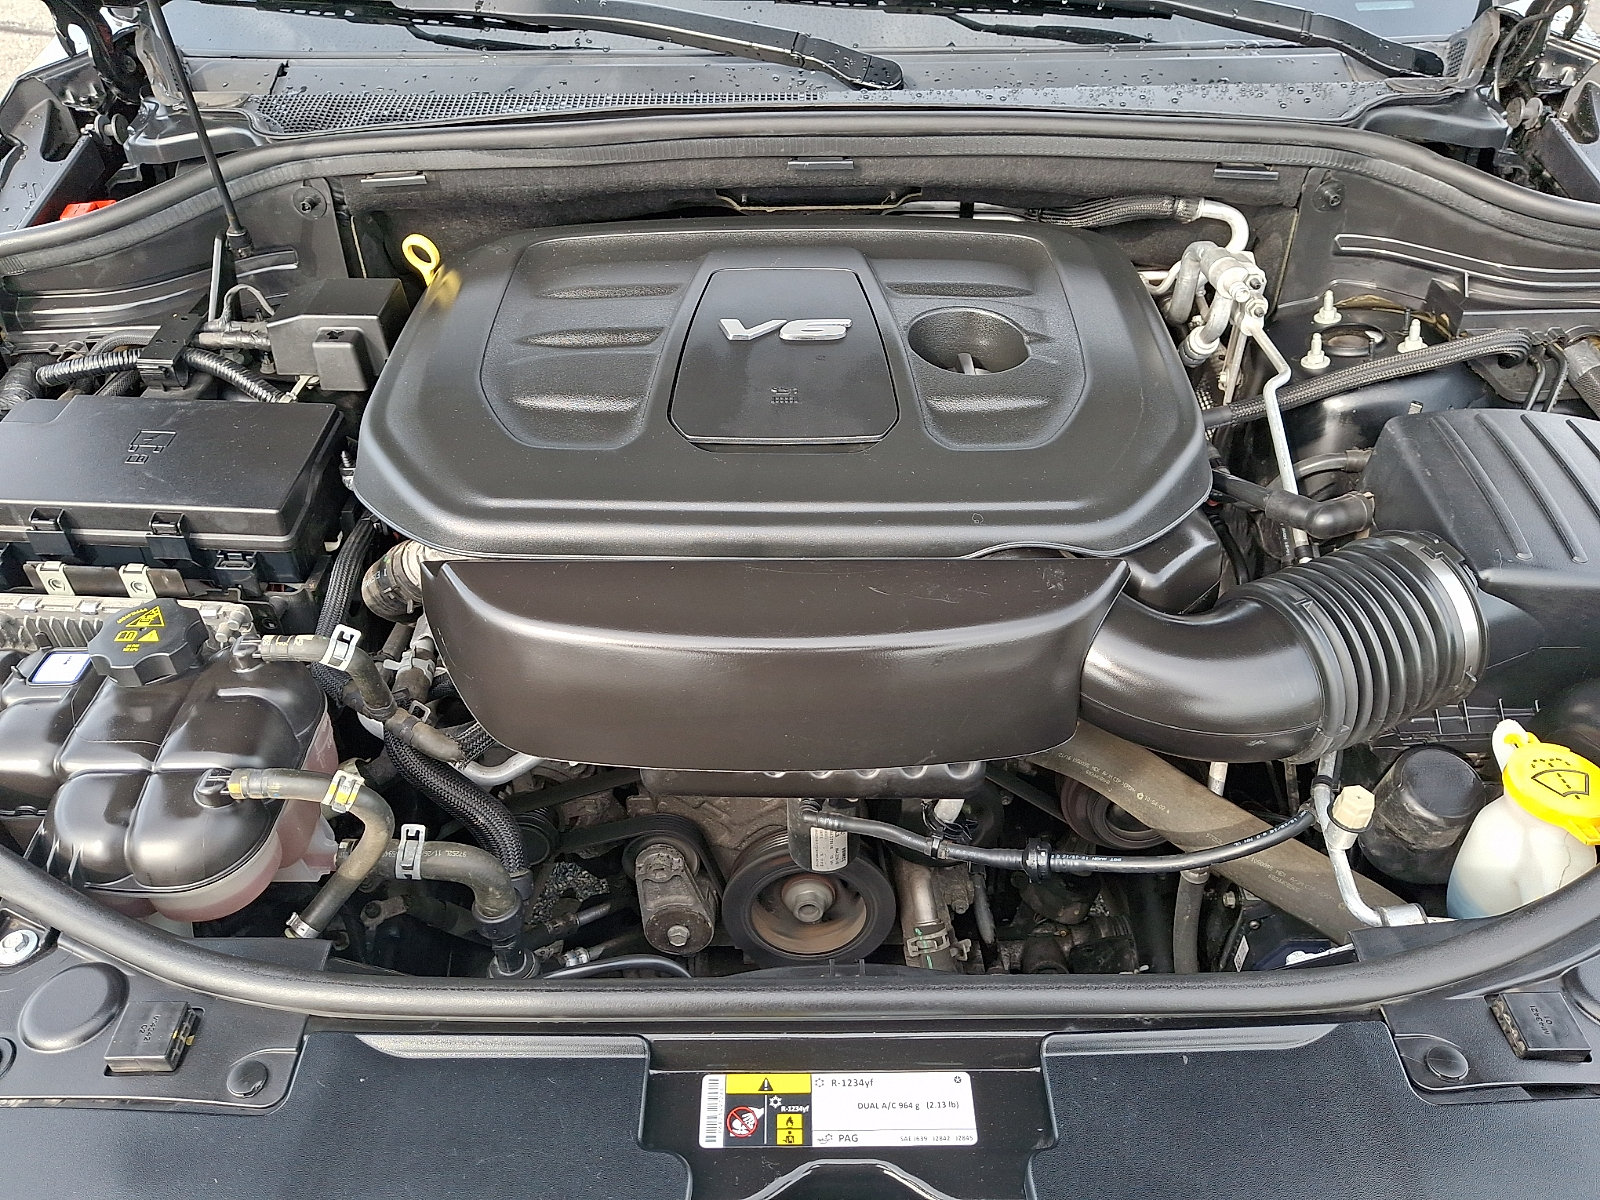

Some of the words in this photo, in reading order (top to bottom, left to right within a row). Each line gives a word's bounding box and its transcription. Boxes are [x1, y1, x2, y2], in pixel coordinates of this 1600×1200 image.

[719, 318, 853, 341] V6
[831, 1078, 874, 1089] R-1234yf
[780, 1104, 810, 1114] R-1234yf
[857, 1102, 879, 1110] DUAL
[881, 1101, 897, 1110] A/C
[838, 1134, 859, 1143] PAG
